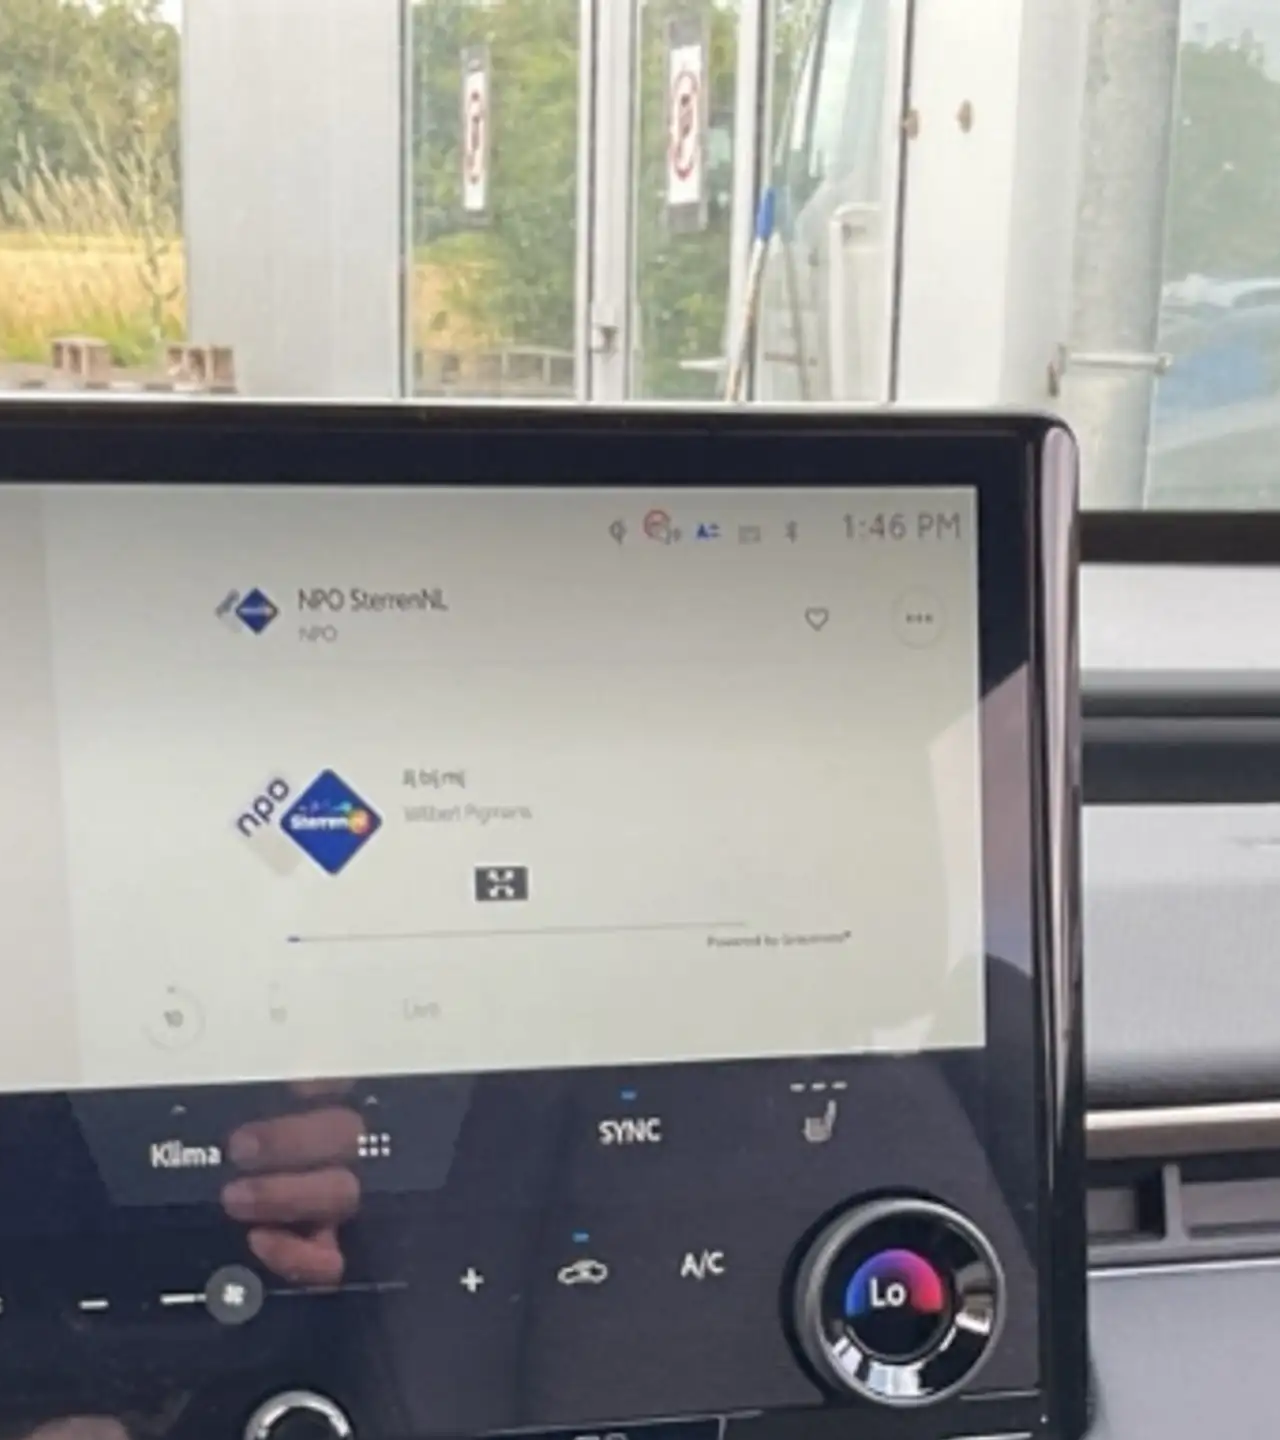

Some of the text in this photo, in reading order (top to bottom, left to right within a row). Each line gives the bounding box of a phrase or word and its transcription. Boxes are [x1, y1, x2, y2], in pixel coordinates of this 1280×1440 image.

[843, 512, 962, 541] 1:46 PM
[298, 587, 448, 612] NPO SterrenNL
[298, 625, 338, 642] NPO
[235, 777, 290, 838] npo
[598, 1116, 663, 1146] SYNC
[150, 1140, 222, 1168] Klima
[680, 1248, 726, 1281] A/C
[870, 1276, 908, 1309] Lo
